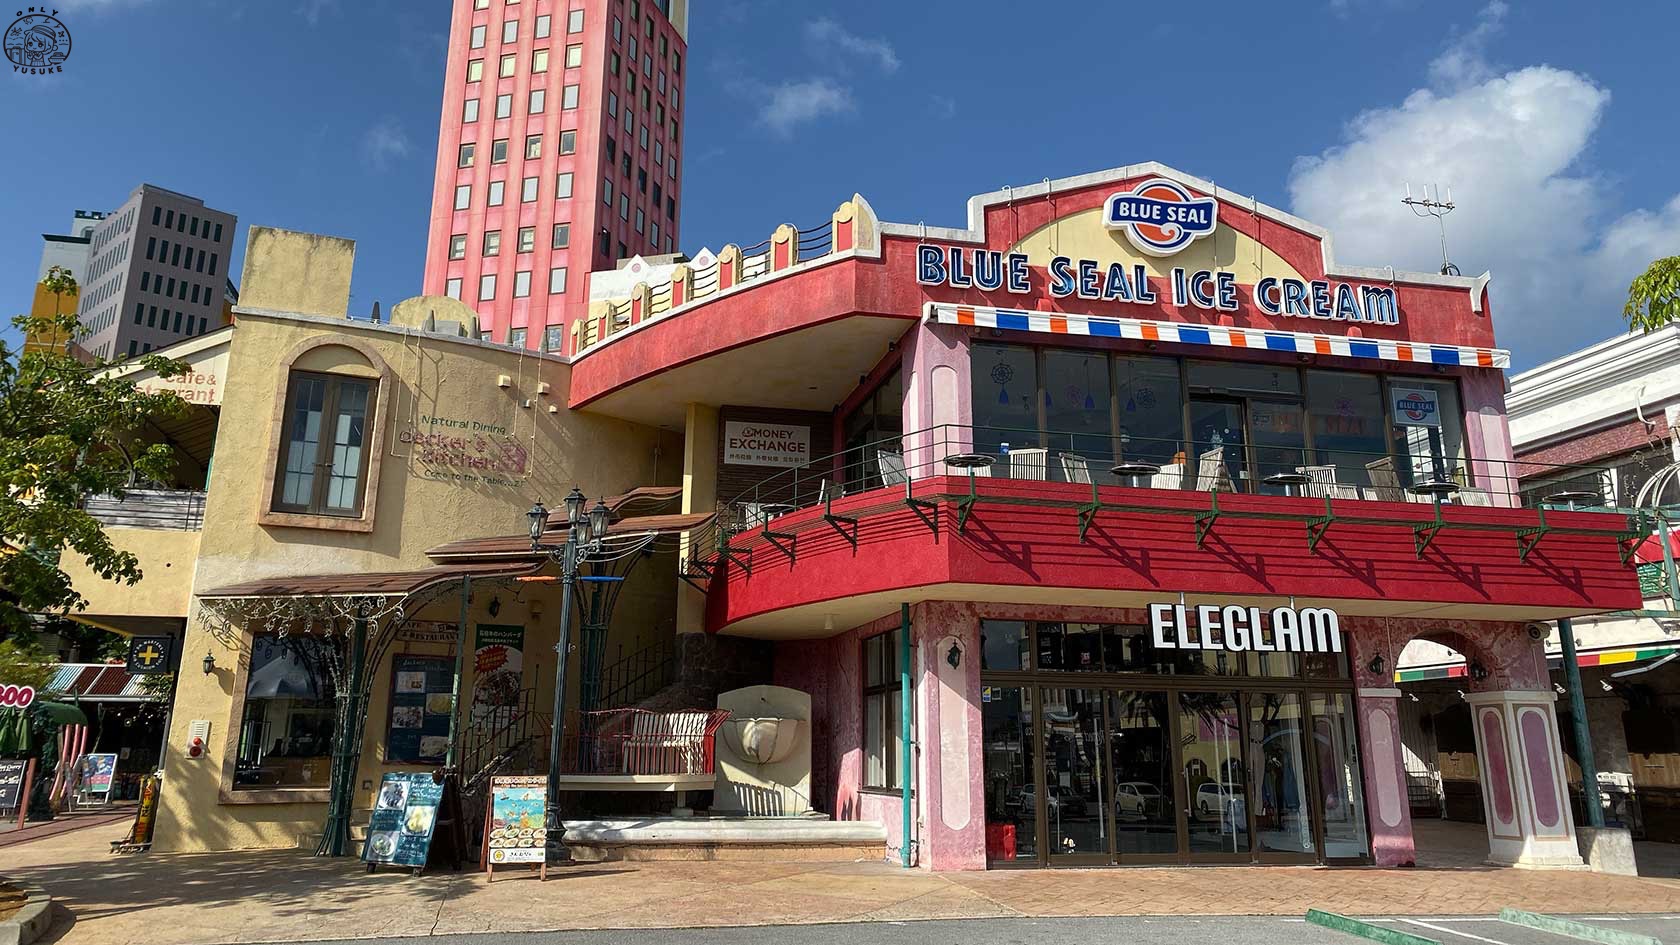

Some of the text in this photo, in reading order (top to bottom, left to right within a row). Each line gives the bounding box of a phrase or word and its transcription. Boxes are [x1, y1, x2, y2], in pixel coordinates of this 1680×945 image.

[1119, 202, 1208, 224] BLUE SEAL
[917, 244, 1031, 293] BLUE
[1048, 256, 1157, 304] SEAL
[1170, 267, 1238, 311] ICE
[1399, 401, 1433, 411] BLUE SEAL
[421, 415, 506, 435] Natural Dining
[753, 428, 794, 439] MONEY
[729, 438, 806, 453] EXCHANGE
[450, 472, 461, 481] to
[464, 472, 479, 482] the
[1149, 603, 1342, 653] ELEGLAM
